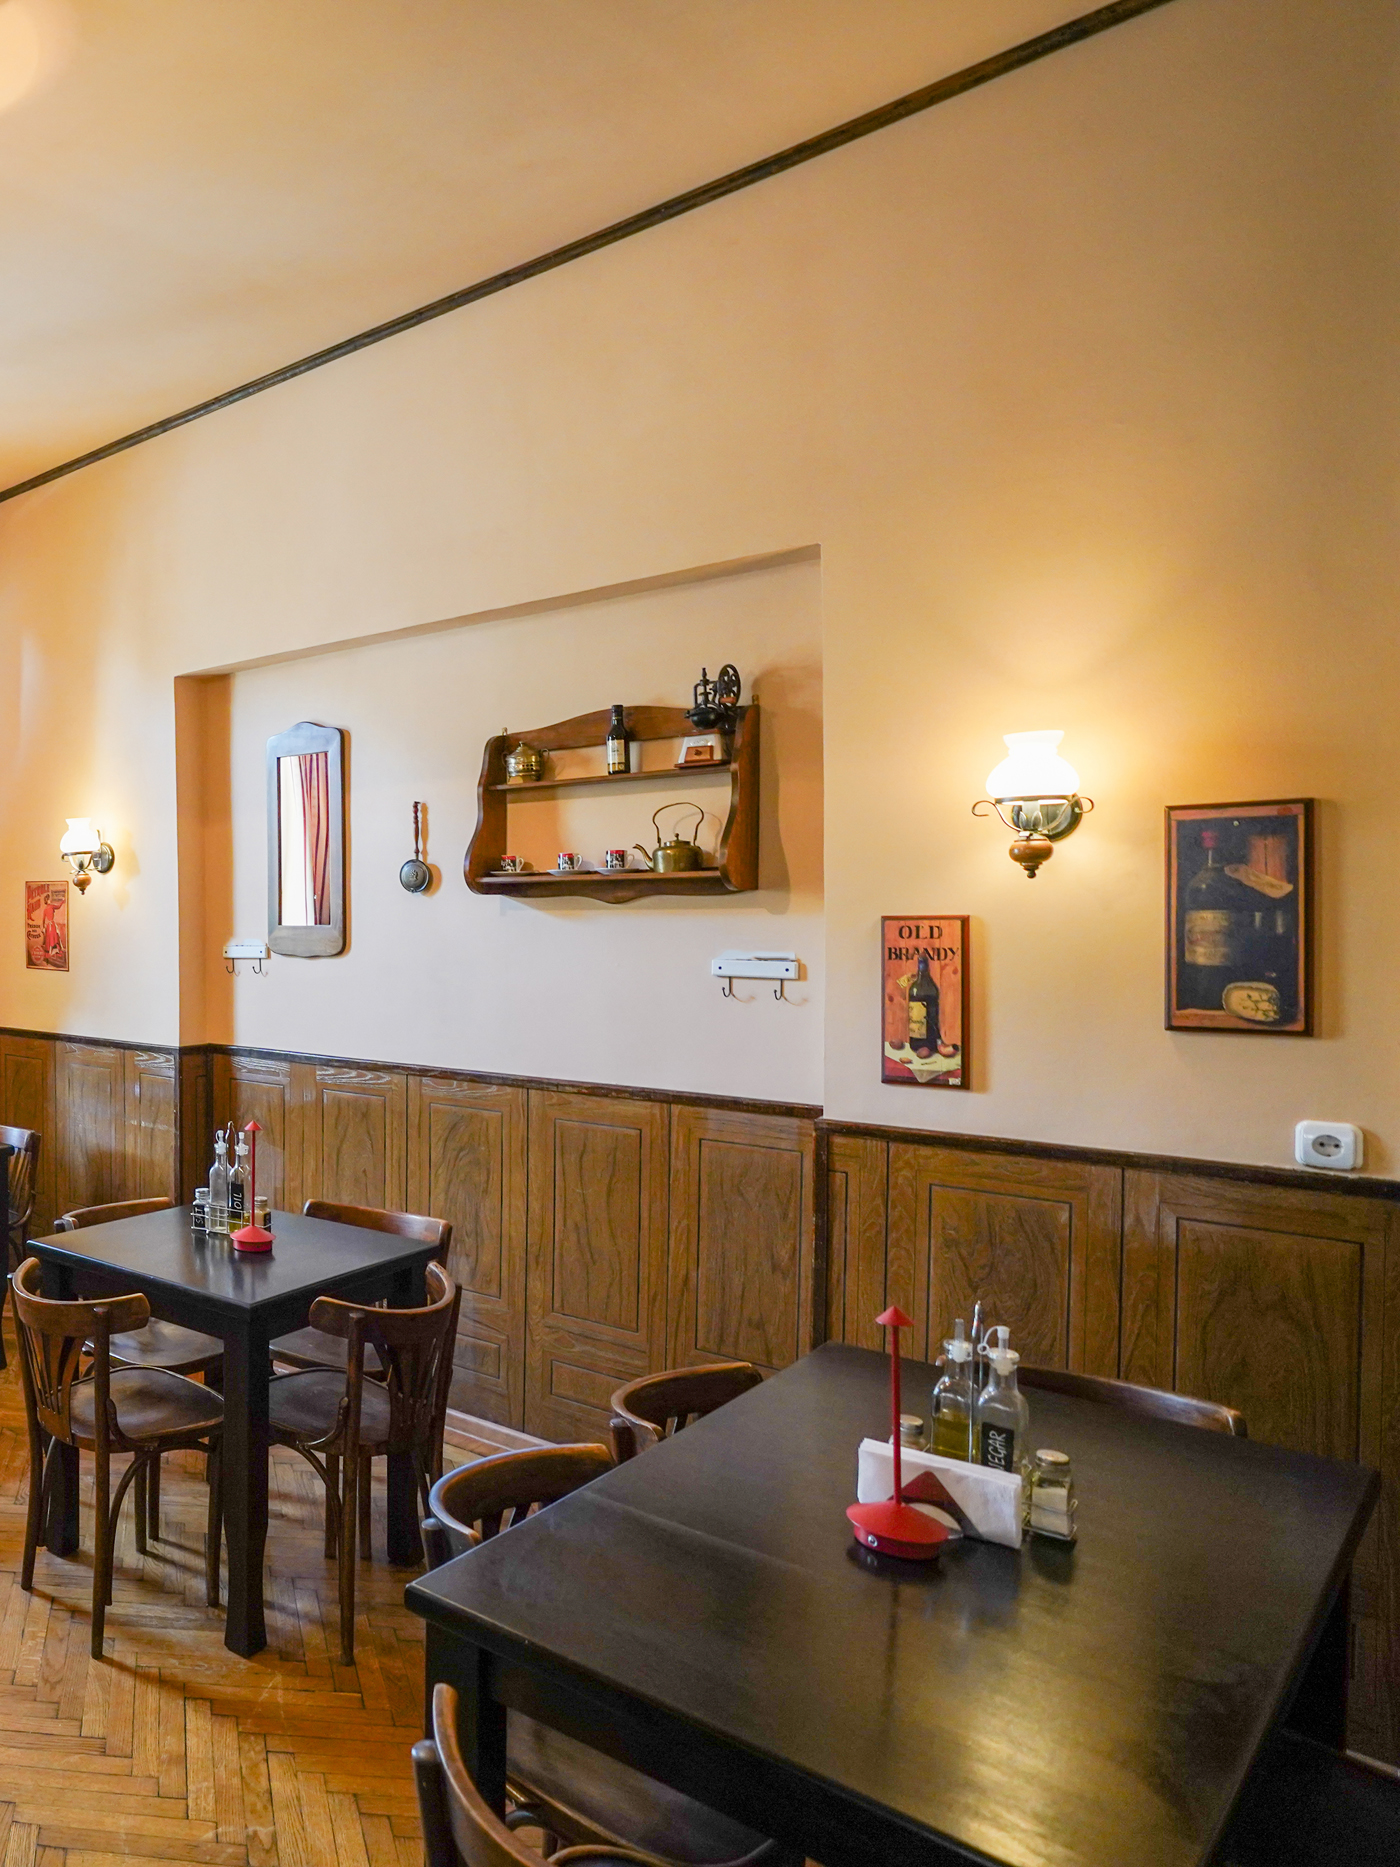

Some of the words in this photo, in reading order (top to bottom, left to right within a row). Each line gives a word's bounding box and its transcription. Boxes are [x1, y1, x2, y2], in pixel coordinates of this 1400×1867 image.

[898, 925, 943, 939] OLD
[887, 946, 959, 961] BRANDY
[233, 1192, 242, 1210] OIL
